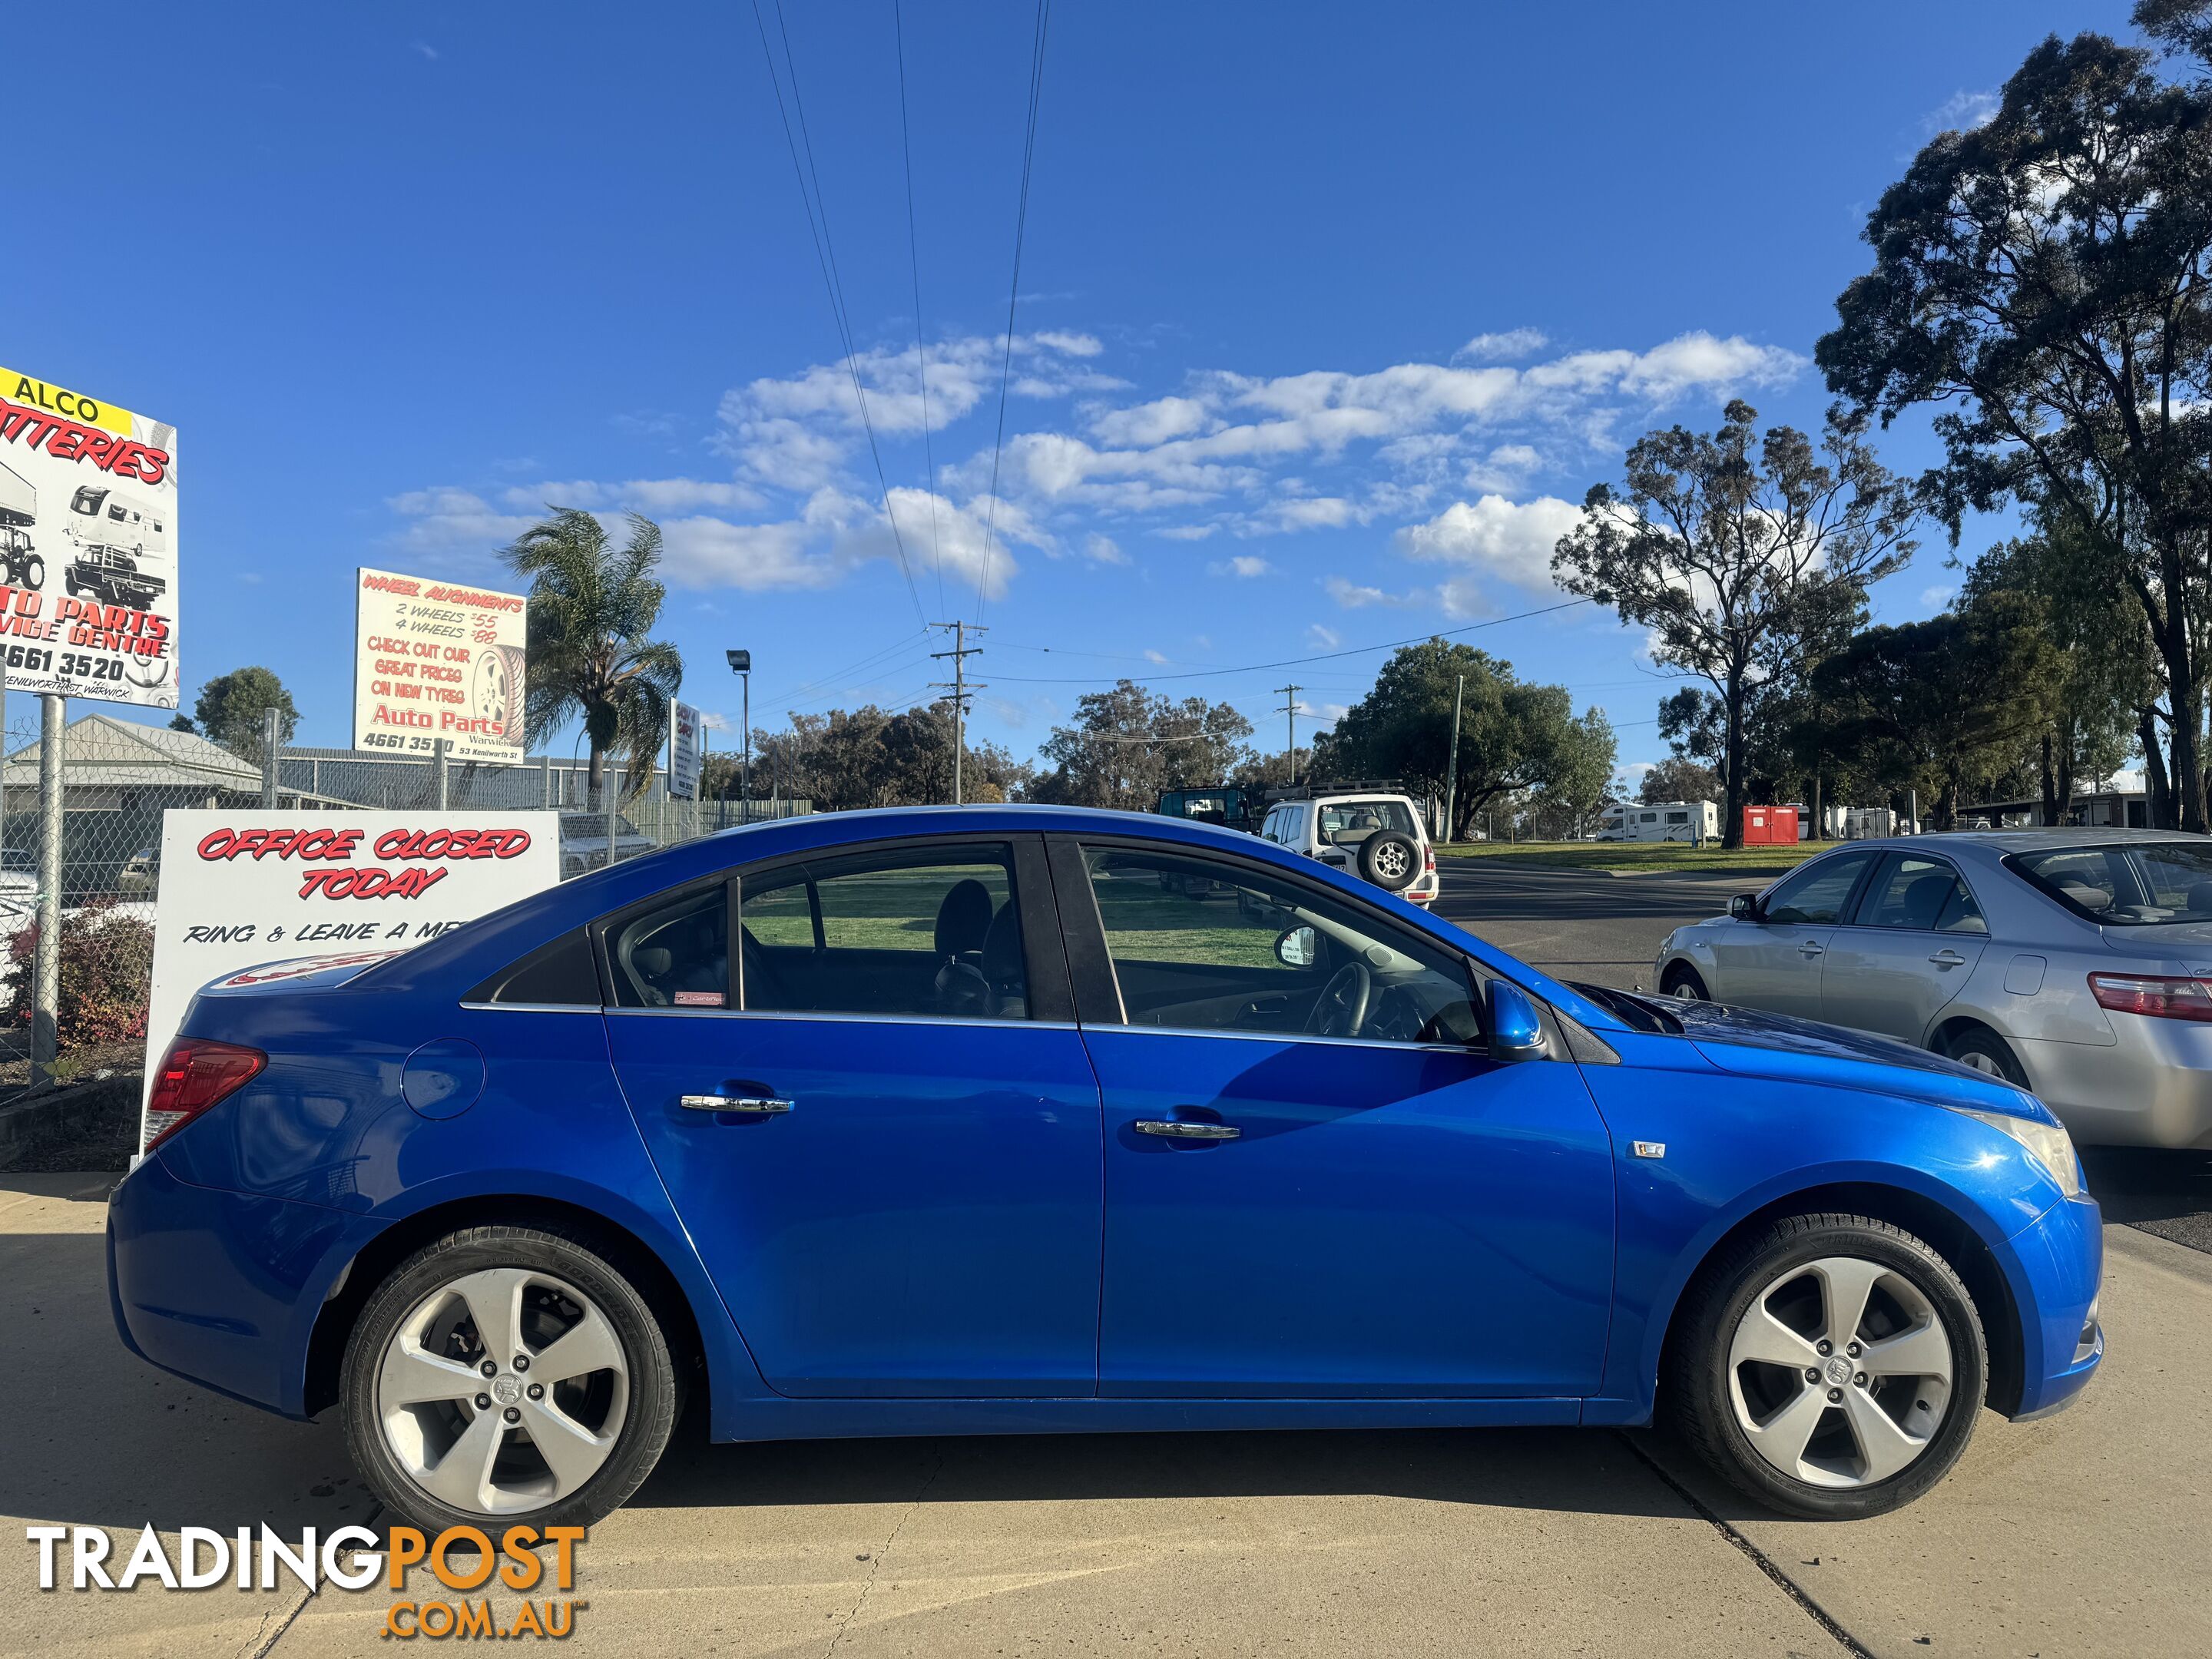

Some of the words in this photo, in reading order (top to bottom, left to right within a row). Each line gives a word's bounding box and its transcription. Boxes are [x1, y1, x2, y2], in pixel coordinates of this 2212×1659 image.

[14, 377, 99, 422] ALCO
[0, 397, 170, 485] TTERIES
[363, 574, 422, 597] WHEEL
[423, 585, 524, 613] ALIGNMENTS
[55, 597, 171, 641] PARTS
[395, 603, 407, 614] 2
[409, 605, 465, 623] WHEELS
[68, 626, 171, 659] CENTRE
[395, 618, 407, 630] 4
[409, 621, 465, 638] WHEELS
[367, 635, 410, 656] CHECK
[412, 642, 441, 660] OUT
[443, 646, 471, 664] OUR
[58, 652, 124, 681] 3520
[374, 658, 417, 677] GREAT
[420, 664, 463, 684] PRICES
[83, 685, 131, 698] WARWICK
[370, 680, 391, 697] ON
[394, 682, 422, 700] NEW
[425, 686, 465, 704] TYRES
[371, 703, 434, 730] Auto
[439, 710, 505, 736] Parts
[363, 732, 406, 749] 4661
[459, 747, 471, 756] 53
[472, 748, 508, 759] Kenilworth
[469, 734, 510, 747] Warwick
[197, 827, 365, 862] OFFICE
[373, 828, 531, 861] CLOSED
[297, 866, 448, 900] TODAY
[183, 924, 256, 944] RING
[267, 926, 286, 942] &
[294, 921, 380, 942] LEAVE
[383, 922, 410, 940] A
[414, 921, 469, 939] ME
